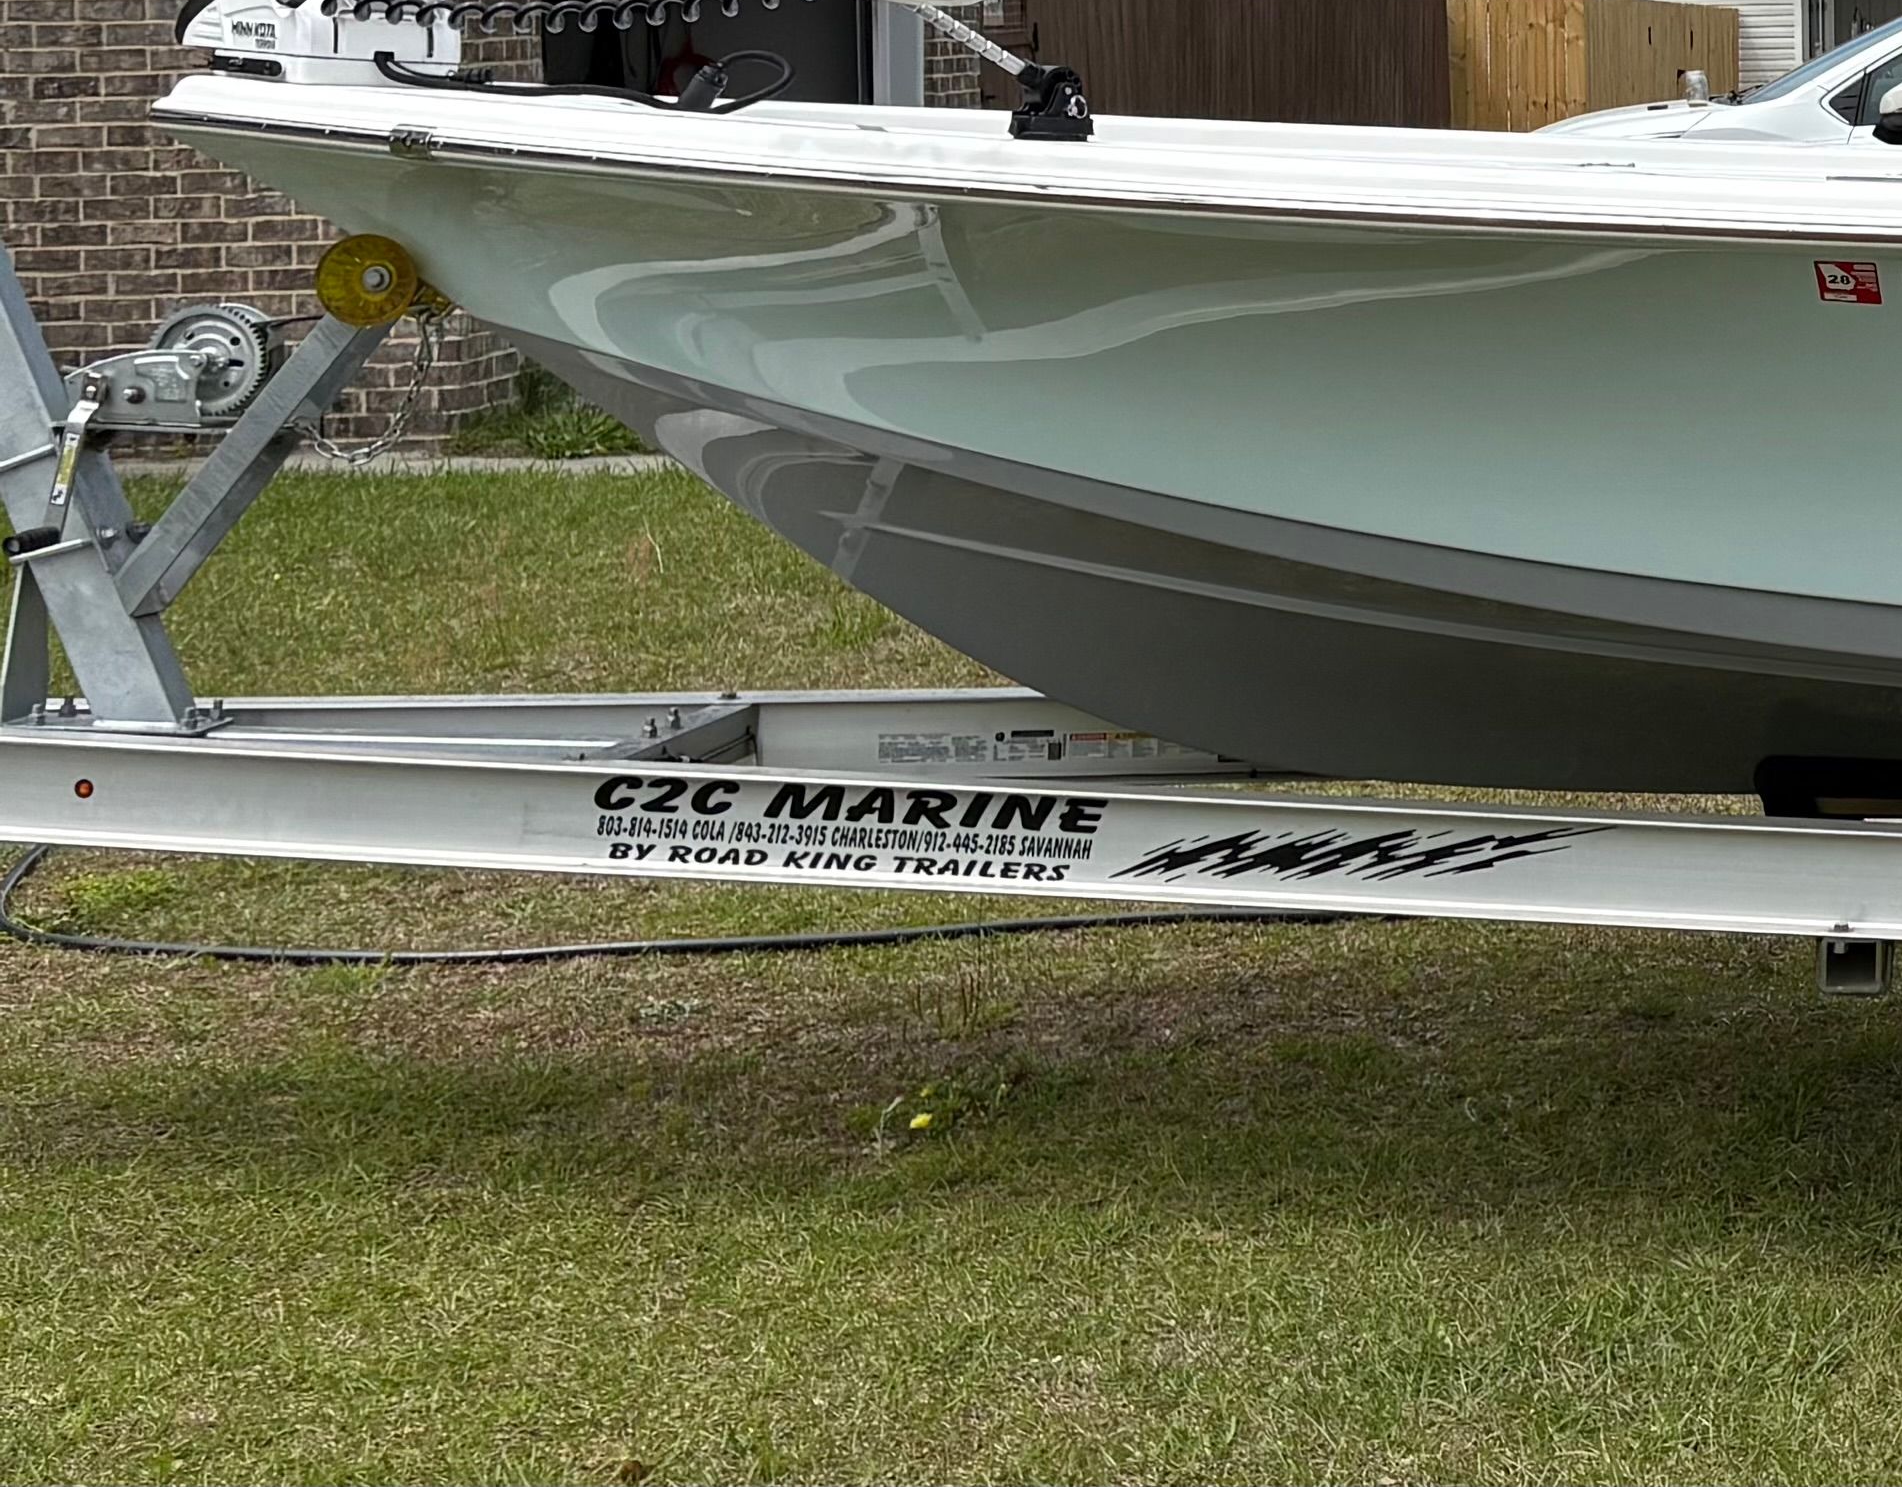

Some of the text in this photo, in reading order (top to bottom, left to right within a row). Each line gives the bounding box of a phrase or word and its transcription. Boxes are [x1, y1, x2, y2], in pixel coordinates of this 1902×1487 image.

[594, 776, 1109, 834] C2C MARINE
[597, 815, 688, 840] 803-814-1514
[692, 820, 726, 842] COLA
[831, 826, 1016, 856] CHARLESTON/912-445-2185
[1019, 836, 1093, 860] SAVANNAH
[609, 842, 1071, 882] BY ROAD KING TRAILERS
